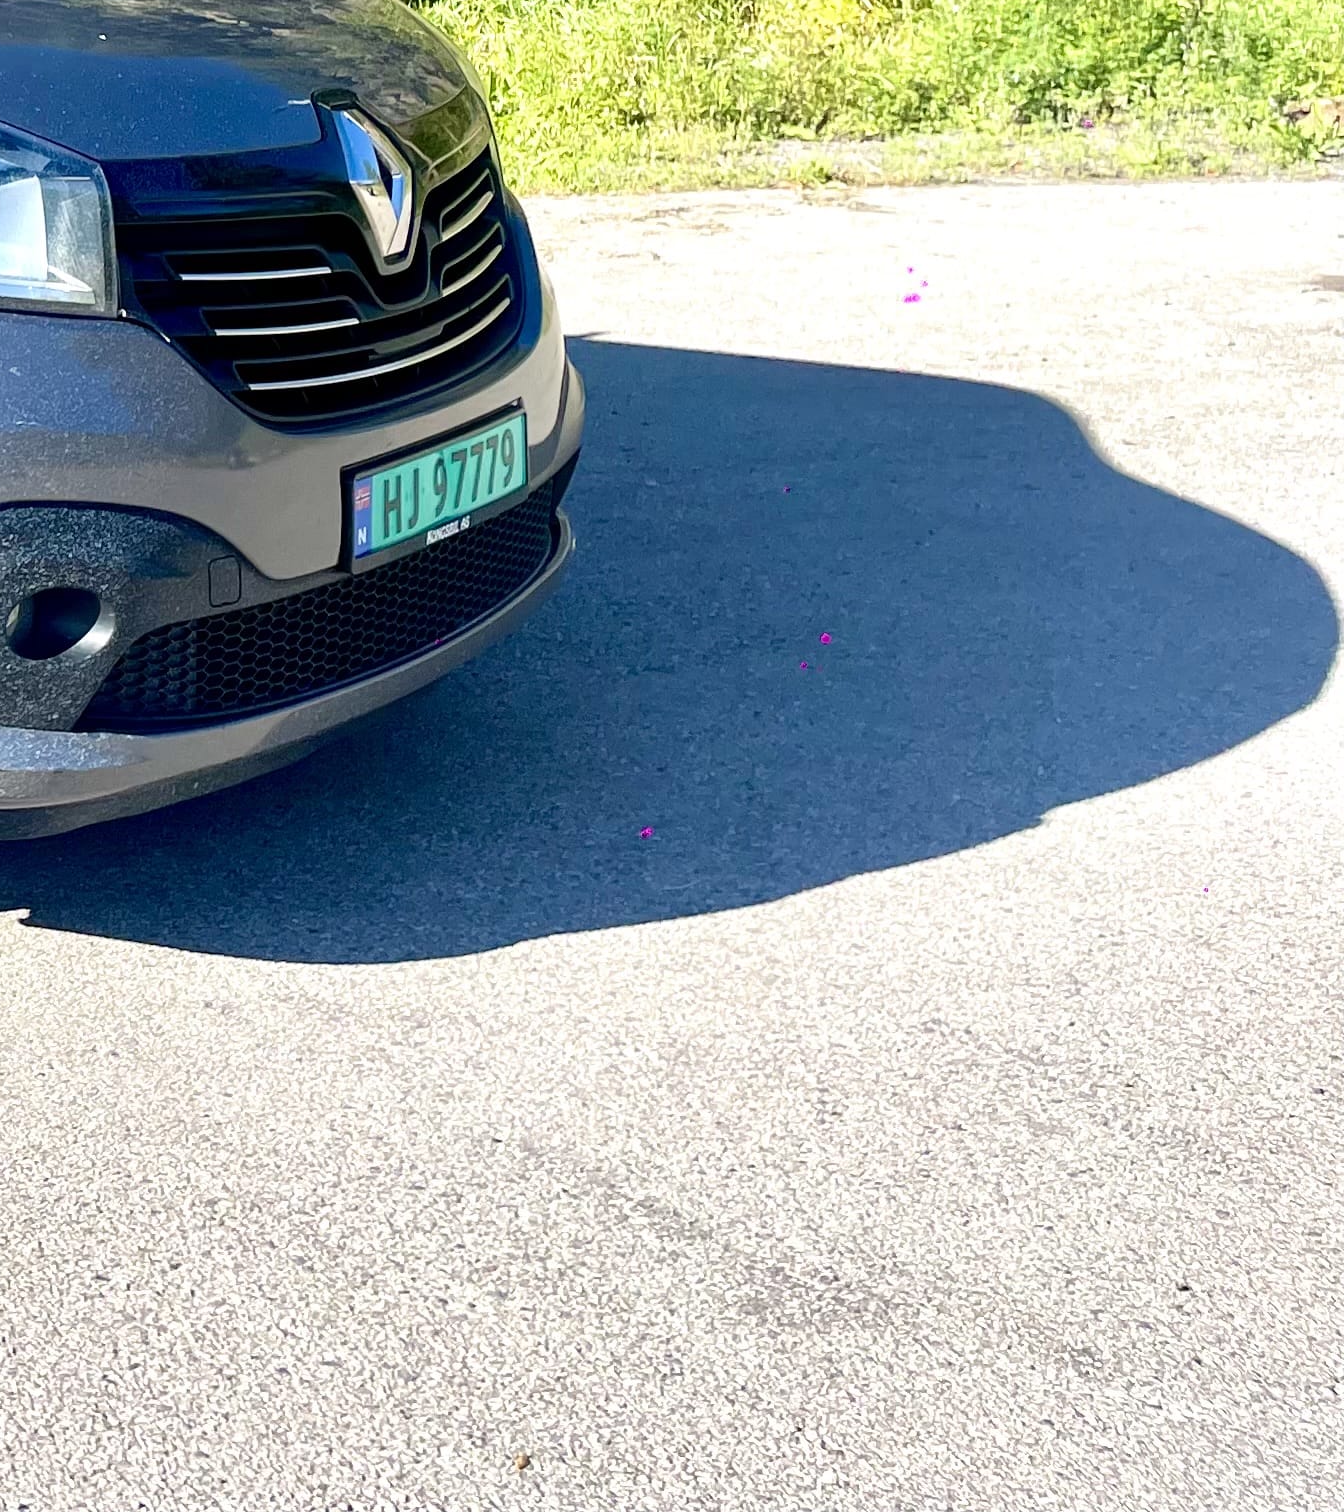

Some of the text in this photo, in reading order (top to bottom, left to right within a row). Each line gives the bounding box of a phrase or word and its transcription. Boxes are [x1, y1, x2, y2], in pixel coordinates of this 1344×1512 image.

[383, 428, 514, 538] HJ 97779
[358, 526, 367, 545] N
